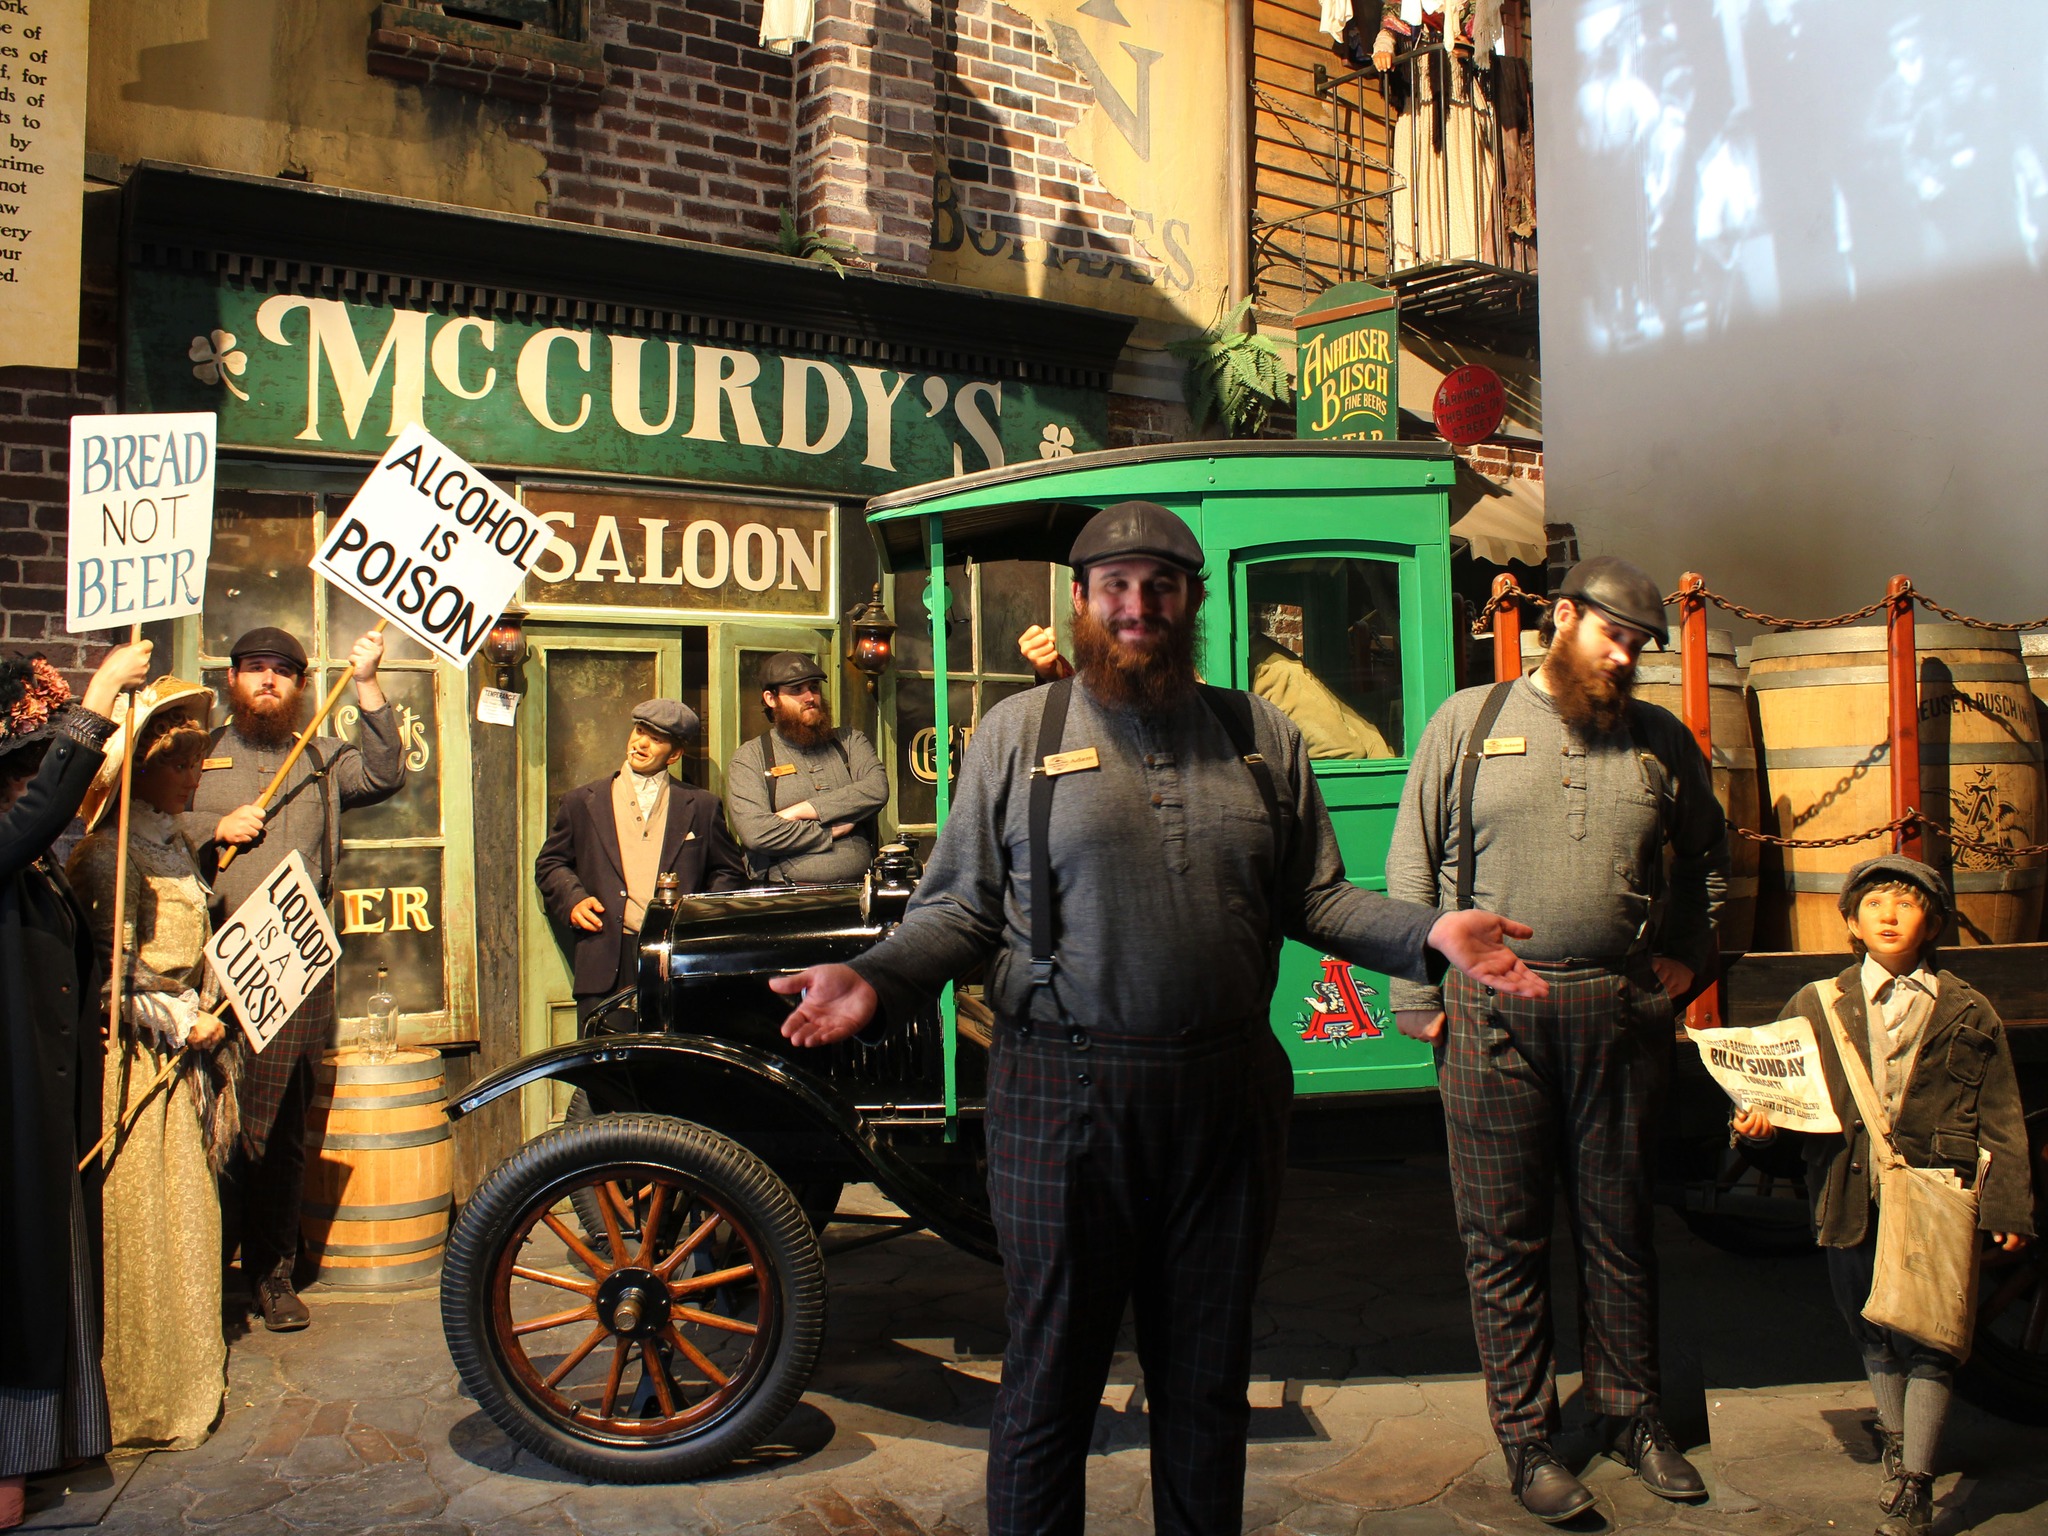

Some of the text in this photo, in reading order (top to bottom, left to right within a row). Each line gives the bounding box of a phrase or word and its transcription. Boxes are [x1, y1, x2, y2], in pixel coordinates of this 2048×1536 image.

[23, 26, 42, 40] of
[30, 50, 48, 64] of
[22, 68, 48, 86] for
[27, 93, 45, 108] of
[22, 114, 41, 130] to
[10, 133, 32, 153] by
[0, 225, 32, 242] ery
[1301, 328, 1394, 401] ANHEUSER
[1457, 370, 1472, 385] NO
[1312, 363, 1388, 432] BUSCH
[1345, 393, 1387, 416] FINE BEERS
[1439, 381, 1496, 408] PARKING ON
[1439, 410, 1463, 426] THIS
[1465, 401, 1488, 418] SIDE
[1452, 416, 1492, 438] STREET
[82, 431, 207, 495] BREAD
[102, 494, 190, 547] NOT
[386, 444, 540, 572] ALCOHOL
[420, 523, 459, 563] IS
[530, 511, 828, 592] SALOON
[77, 549, 201, 619] BEER
[324, 518, 493, 656] POISON
[267, 864, 334, 996] LIQUOR
[255, 917, 292, 982] IS A
[215, 921, 287, 1043] CURSE
[1760, 1039, 1802, 1056] CRUSADER
[1710, 1047, 1806, 1077] BILLY SUNDAY
